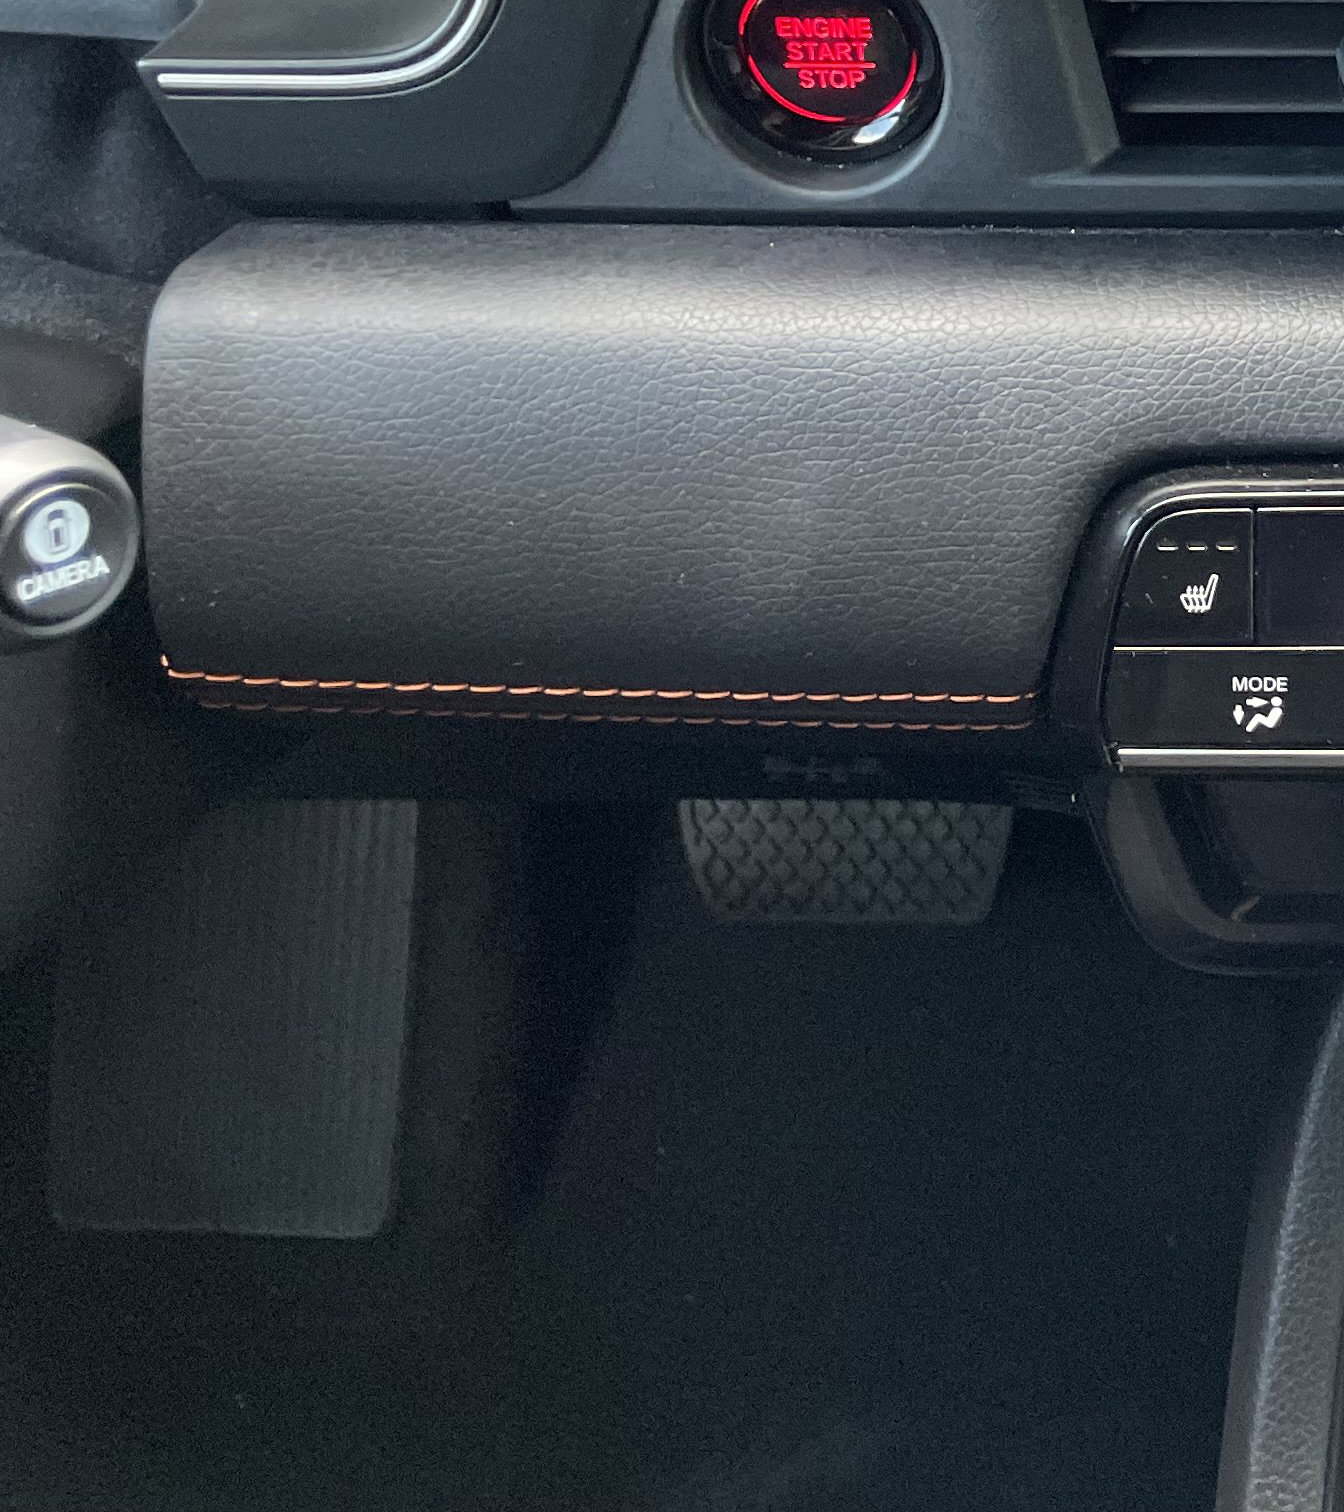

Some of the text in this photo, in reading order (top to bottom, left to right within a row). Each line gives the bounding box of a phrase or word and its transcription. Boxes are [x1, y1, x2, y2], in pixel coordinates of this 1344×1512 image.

[774, 16, 873, 39] ENGINE
[786, 41, 868, 62] START
[798, 69, 866, 89] STOP
[17, 554, 110, 602] CAMERA
[1231, 676, 1289, 693] MODE
